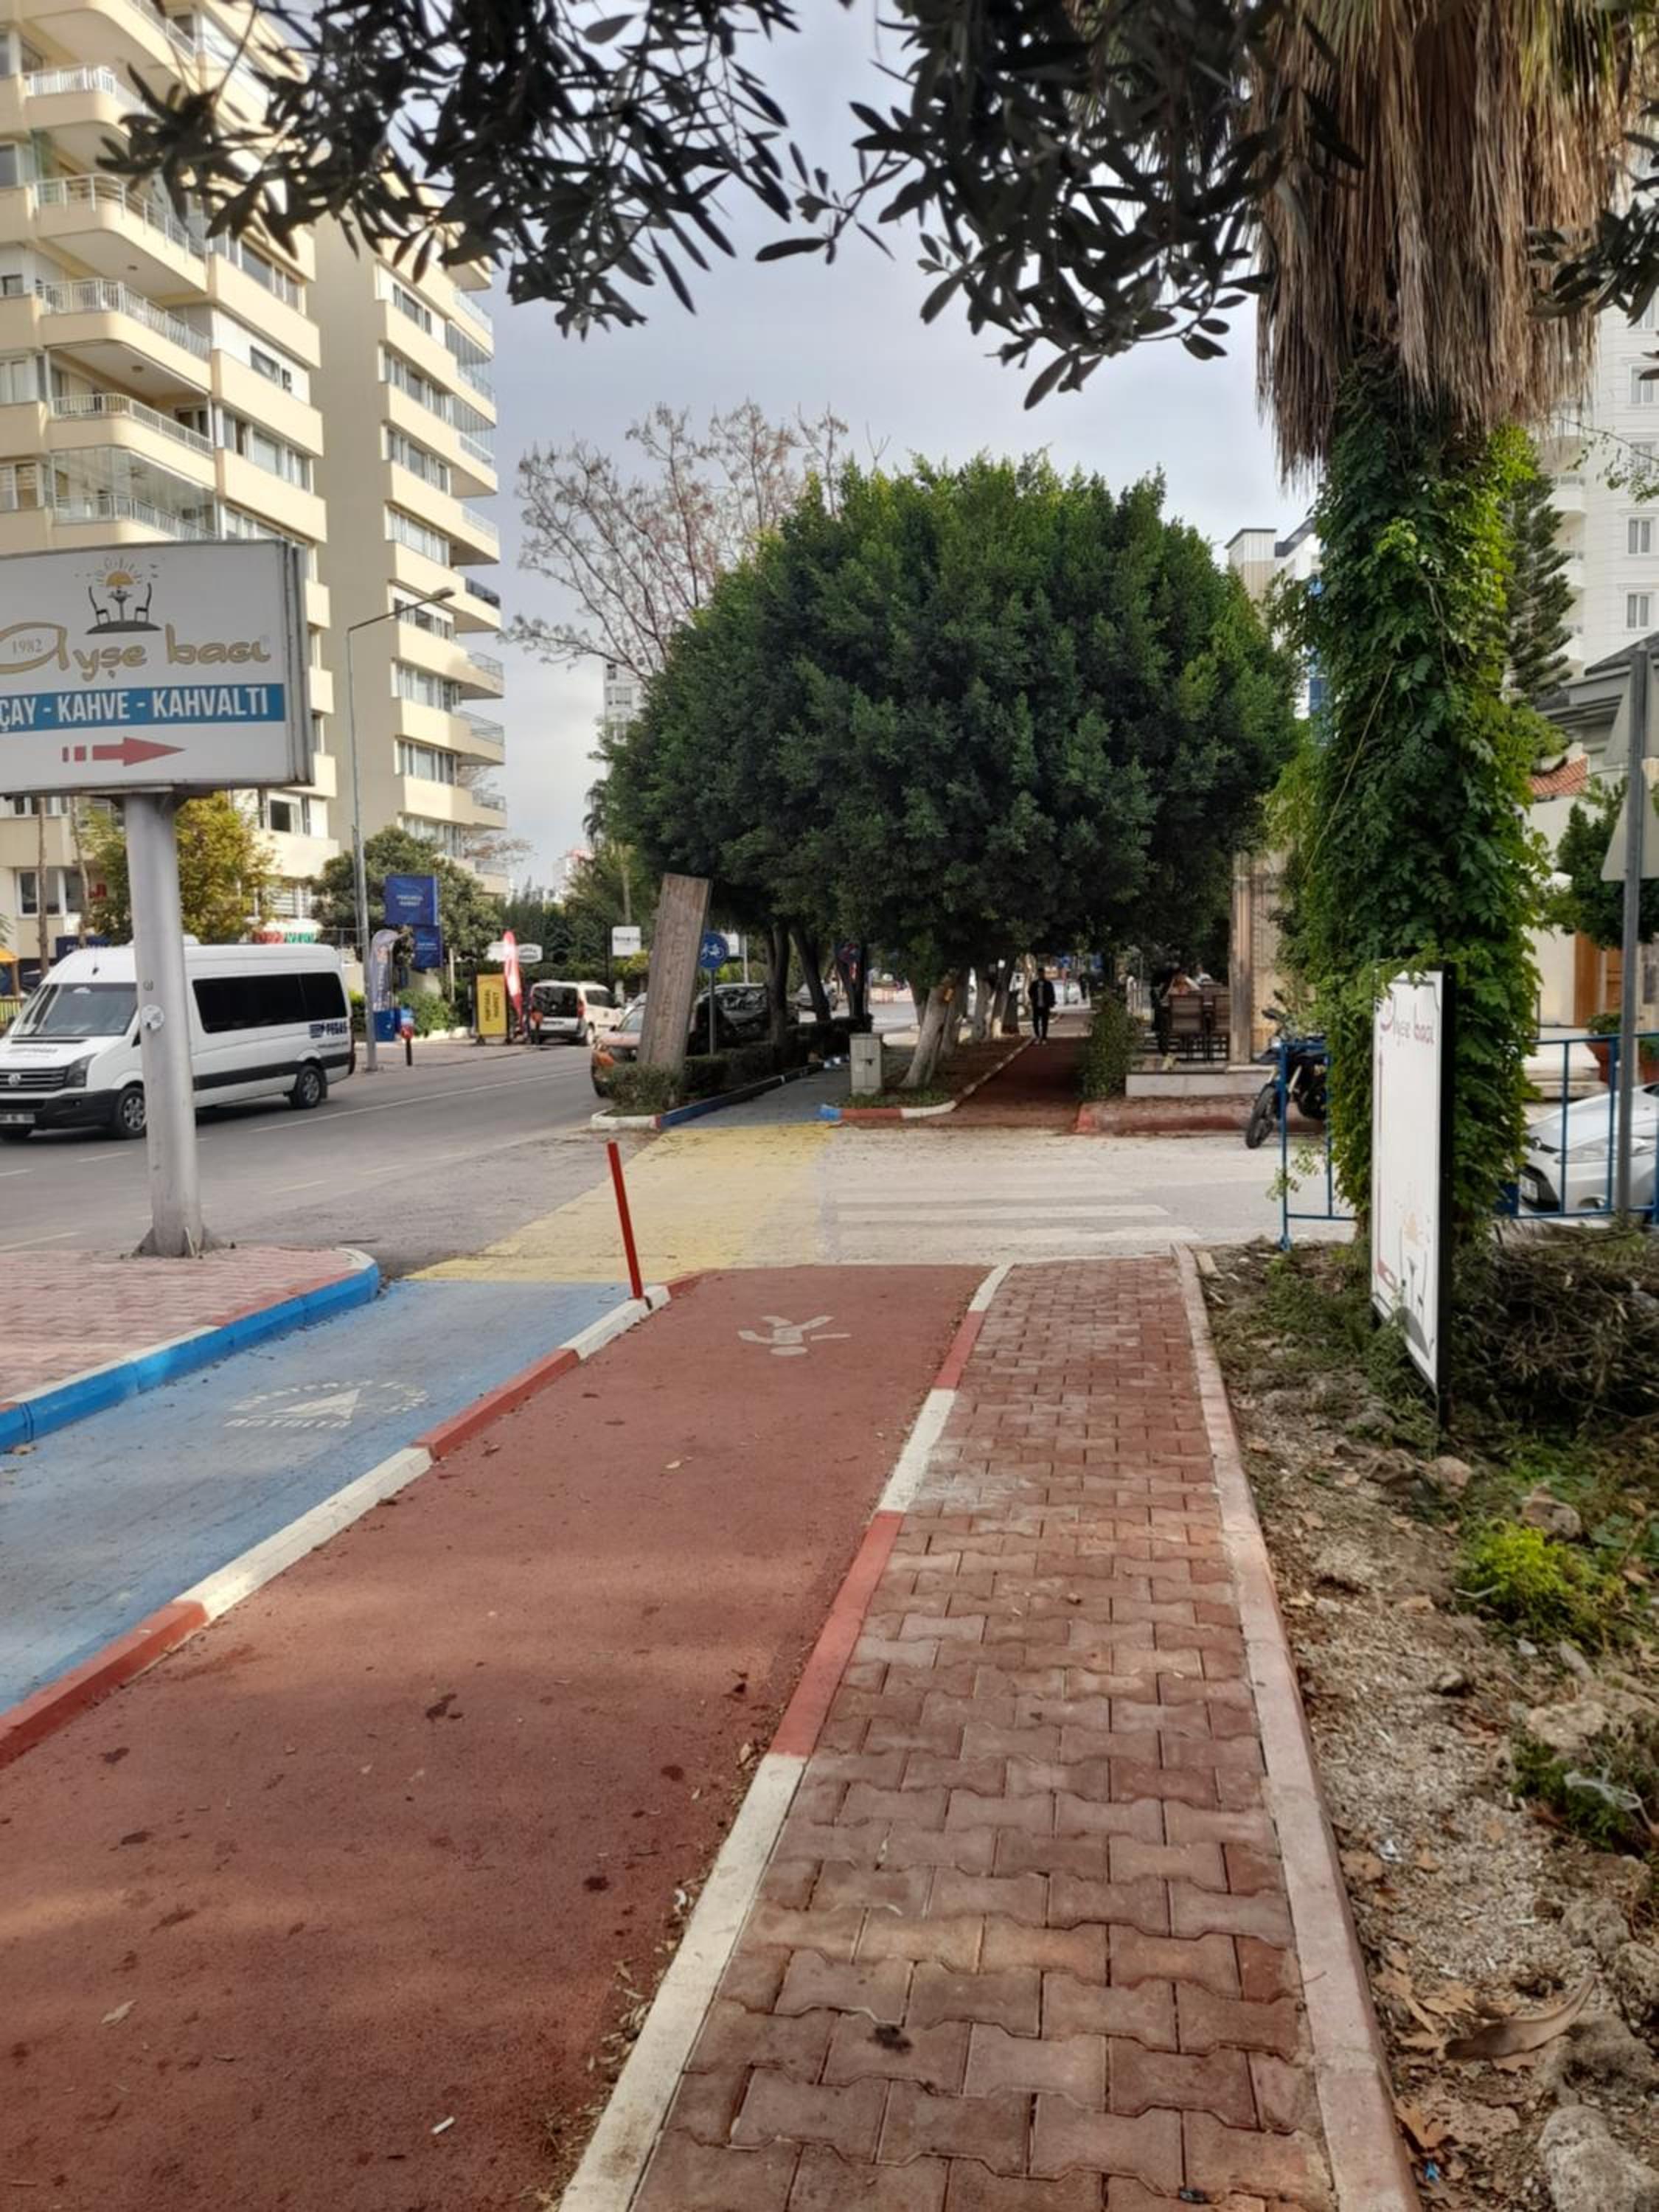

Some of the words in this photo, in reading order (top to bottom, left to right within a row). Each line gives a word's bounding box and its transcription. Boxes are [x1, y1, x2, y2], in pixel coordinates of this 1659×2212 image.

[0, 696, 36, 732] ÇAY
[58, 692, 131, 723] KAHVE
[152, 686, 268, 718] KAHVALTI
